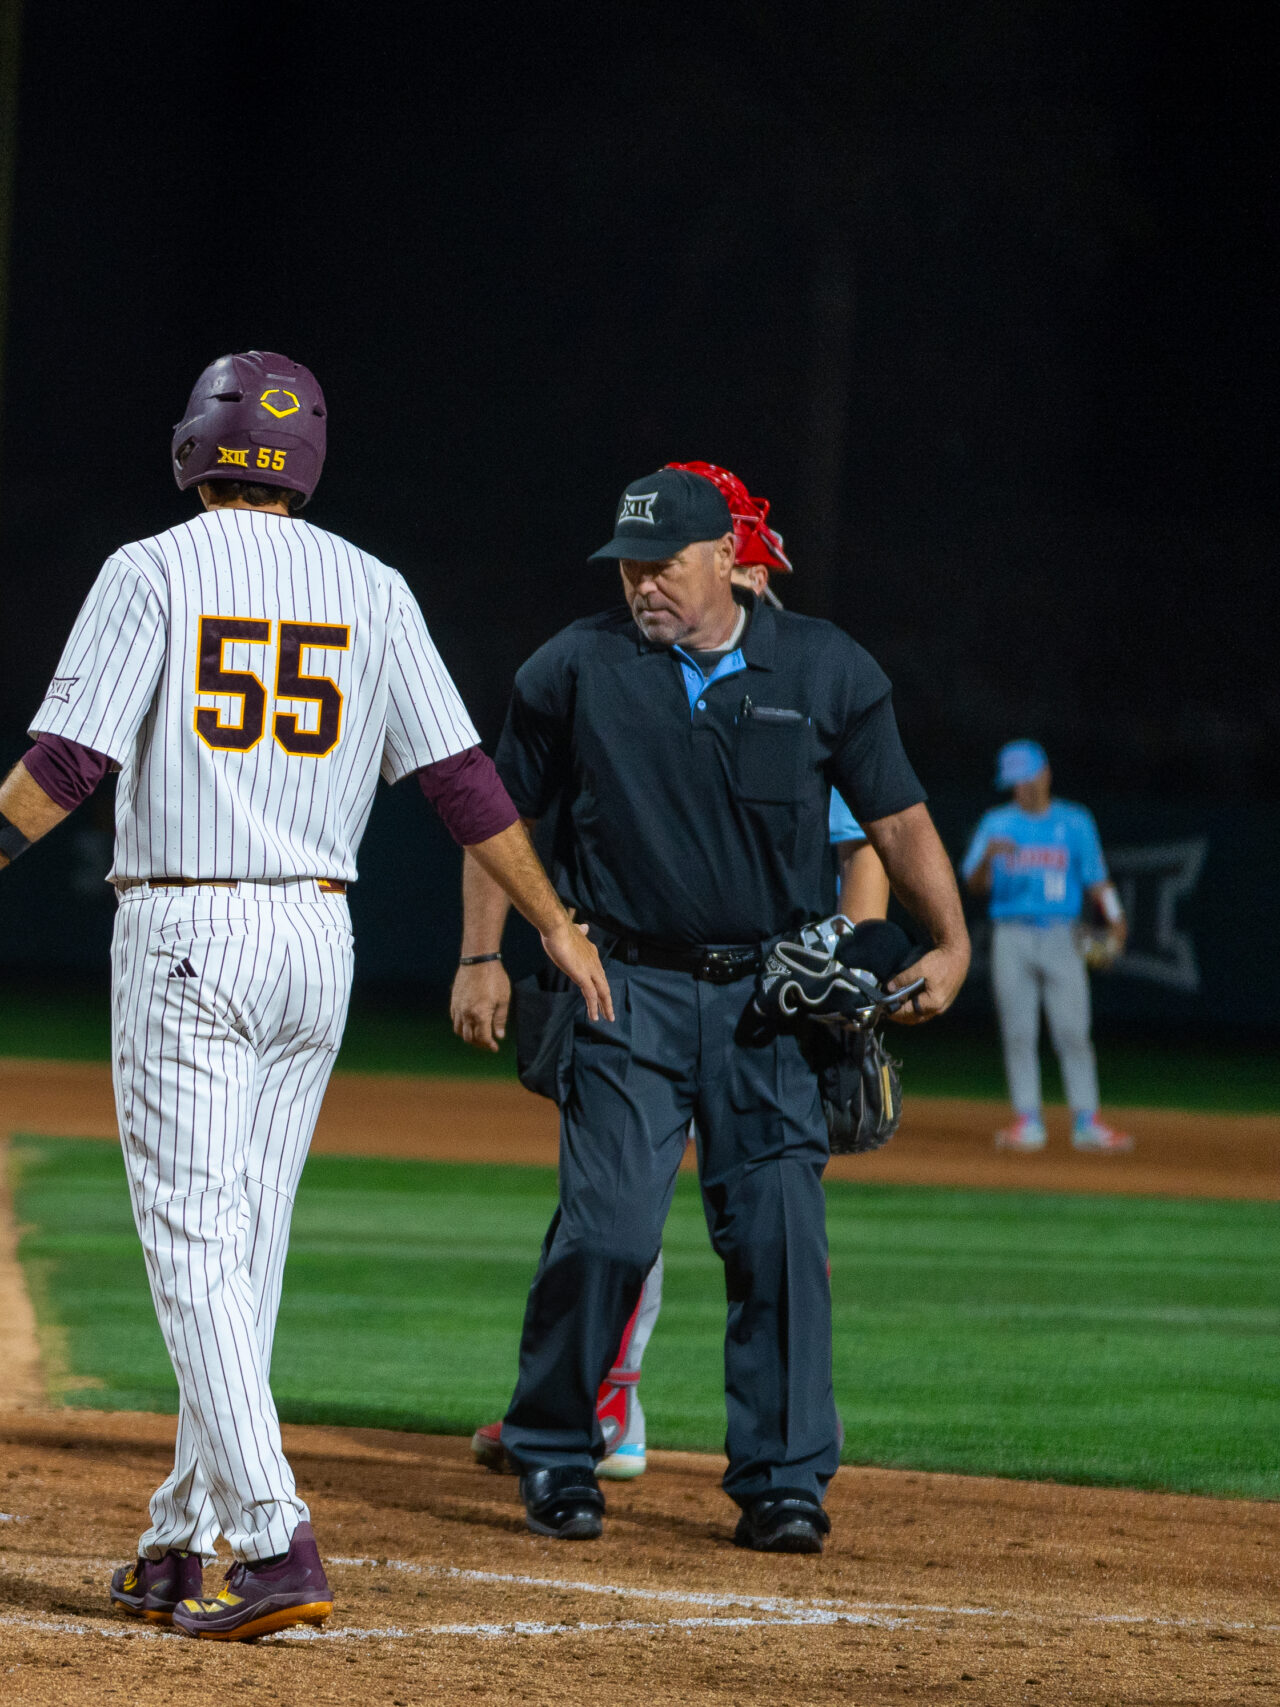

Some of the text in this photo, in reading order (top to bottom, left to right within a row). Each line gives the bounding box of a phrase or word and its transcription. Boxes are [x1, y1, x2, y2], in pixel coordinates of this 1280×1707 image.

[217, 446, 287, 471] XII 55
[619, 492, 657, 524] XII
[194, 615, 350, 758] 55
